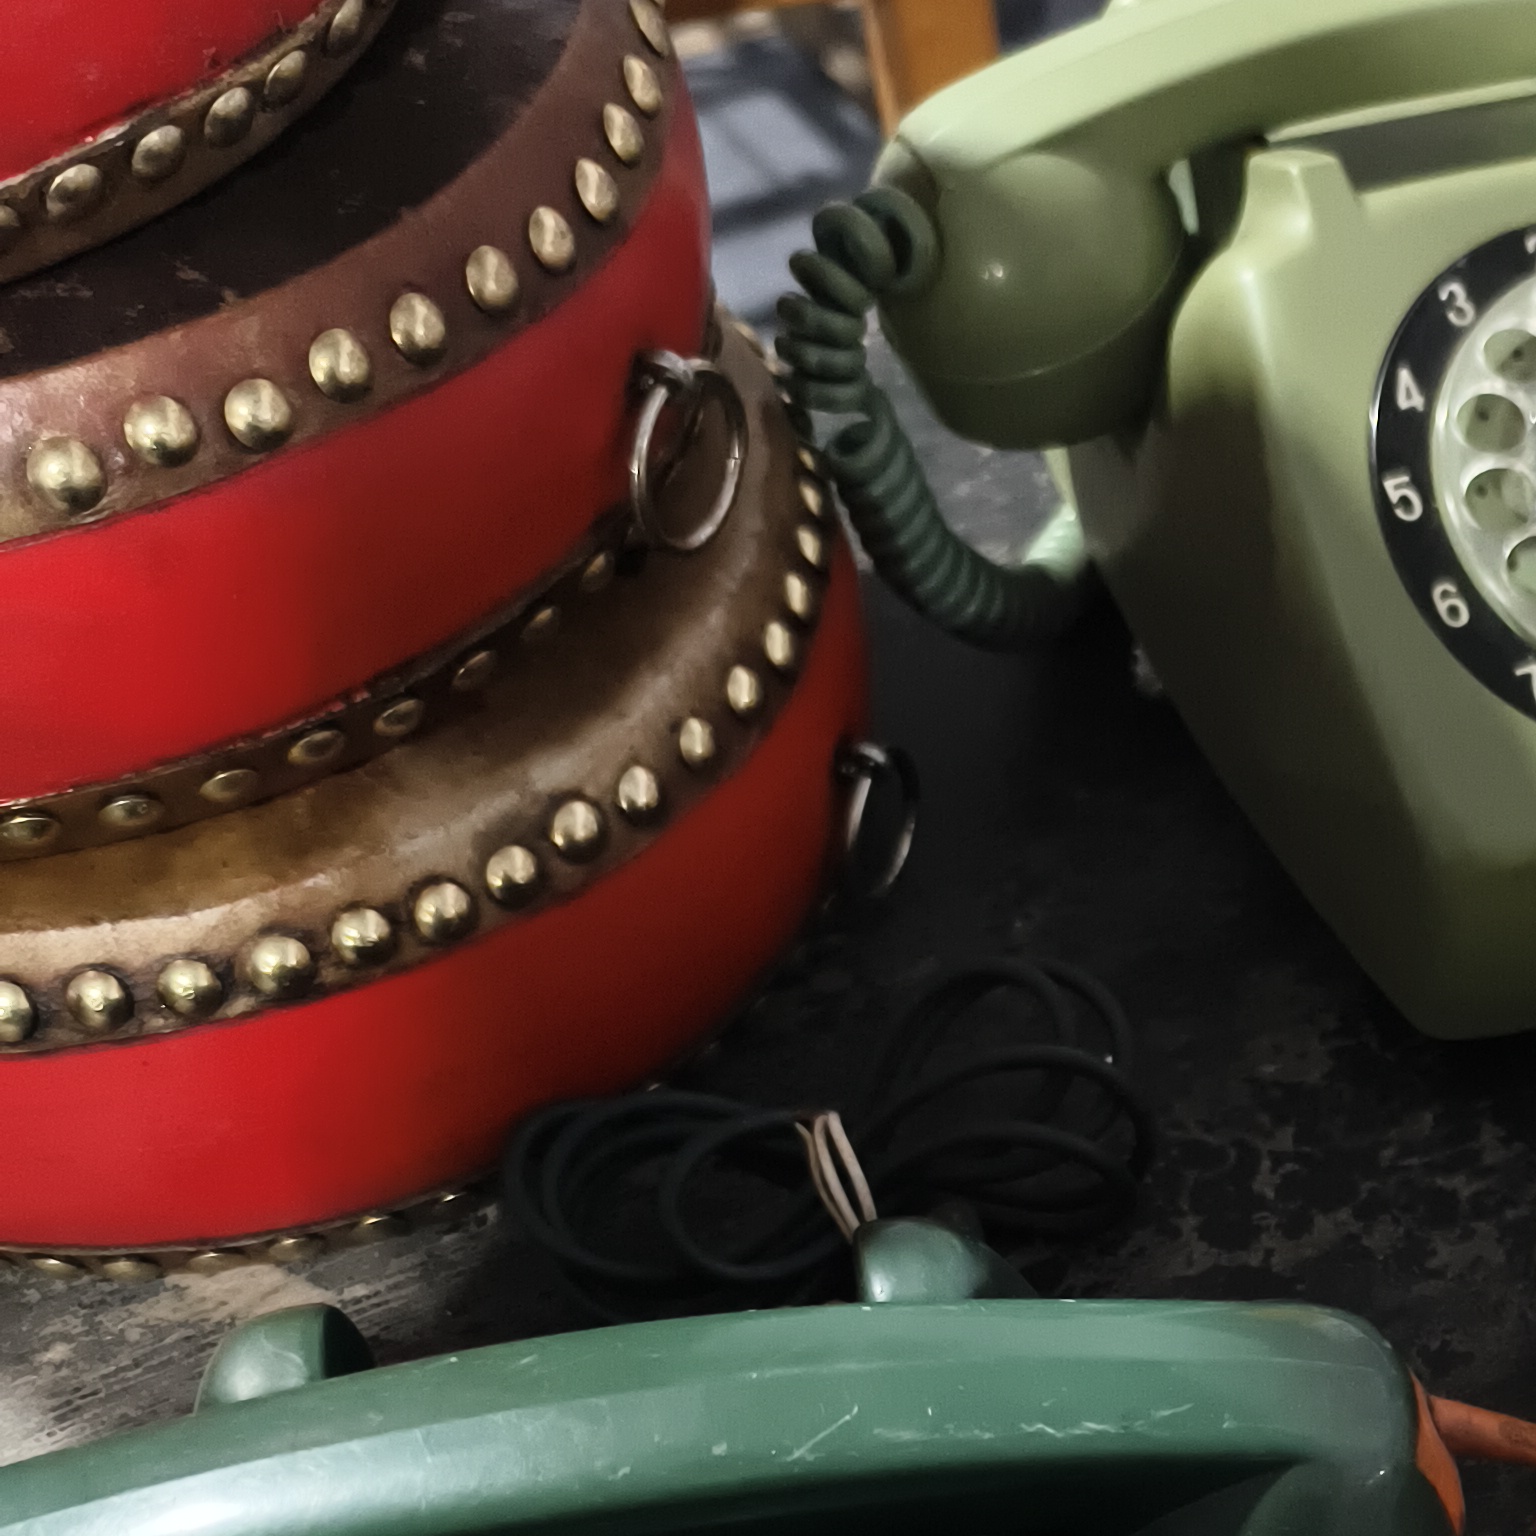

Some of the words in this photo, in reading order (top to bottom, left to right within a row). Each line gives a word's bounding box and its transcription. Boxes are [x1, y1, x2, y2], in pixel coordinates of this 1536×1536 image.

[1438, 283, 1476, 327] 3
[1395, 368, 1426, 413] 4
[1381, 475, 1423, 522] 5
[1431, 584, 1471, 628] 6
